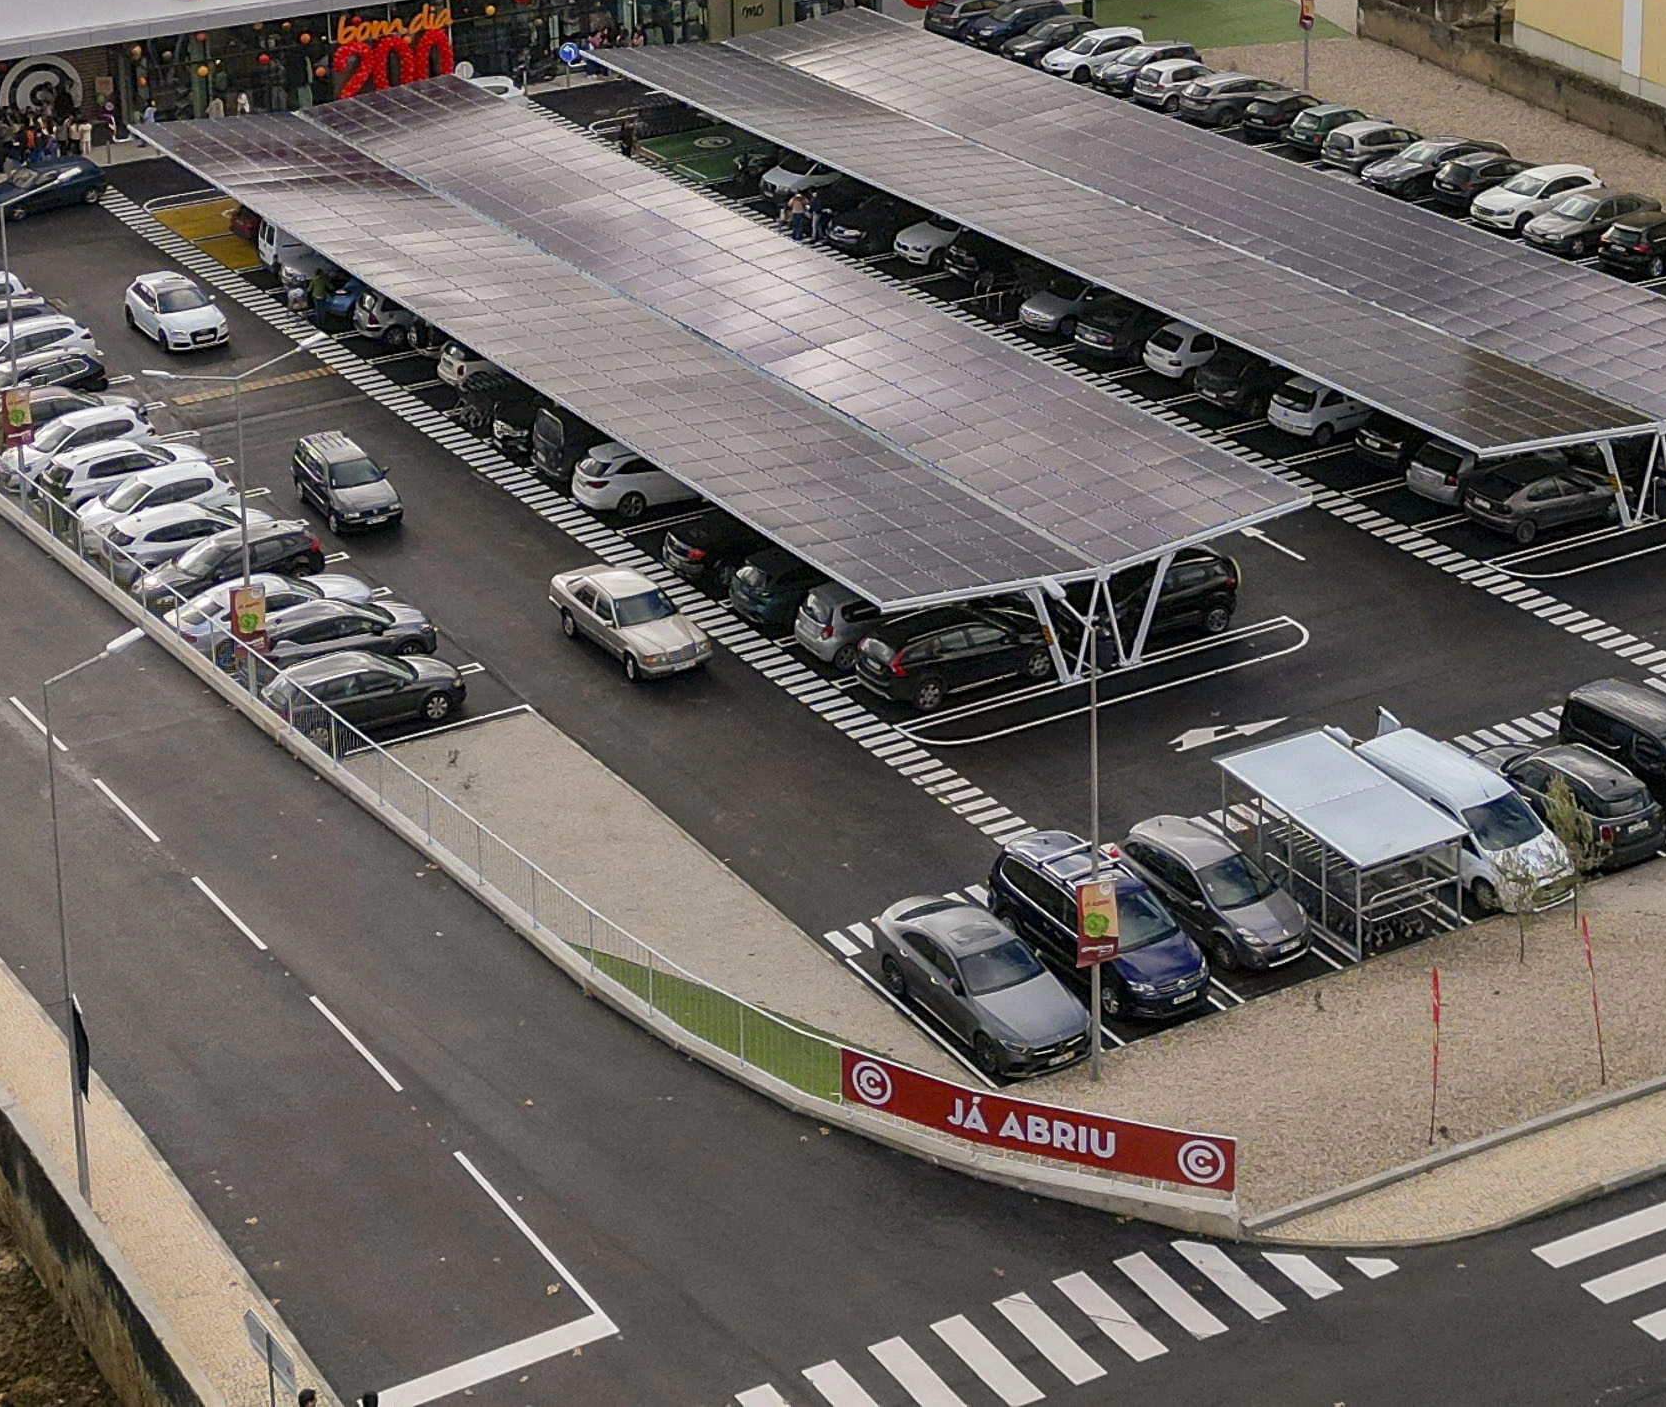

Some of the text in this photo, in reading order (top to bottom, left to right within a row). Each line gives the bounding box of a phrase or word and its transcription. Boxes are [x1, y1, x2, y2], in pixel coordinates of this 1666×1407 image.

[337, 3, 453, 45] bom dia
[332, 28, 455, 100] 200
[946, 1096, 1116, 1159] JÁ ABRIU
